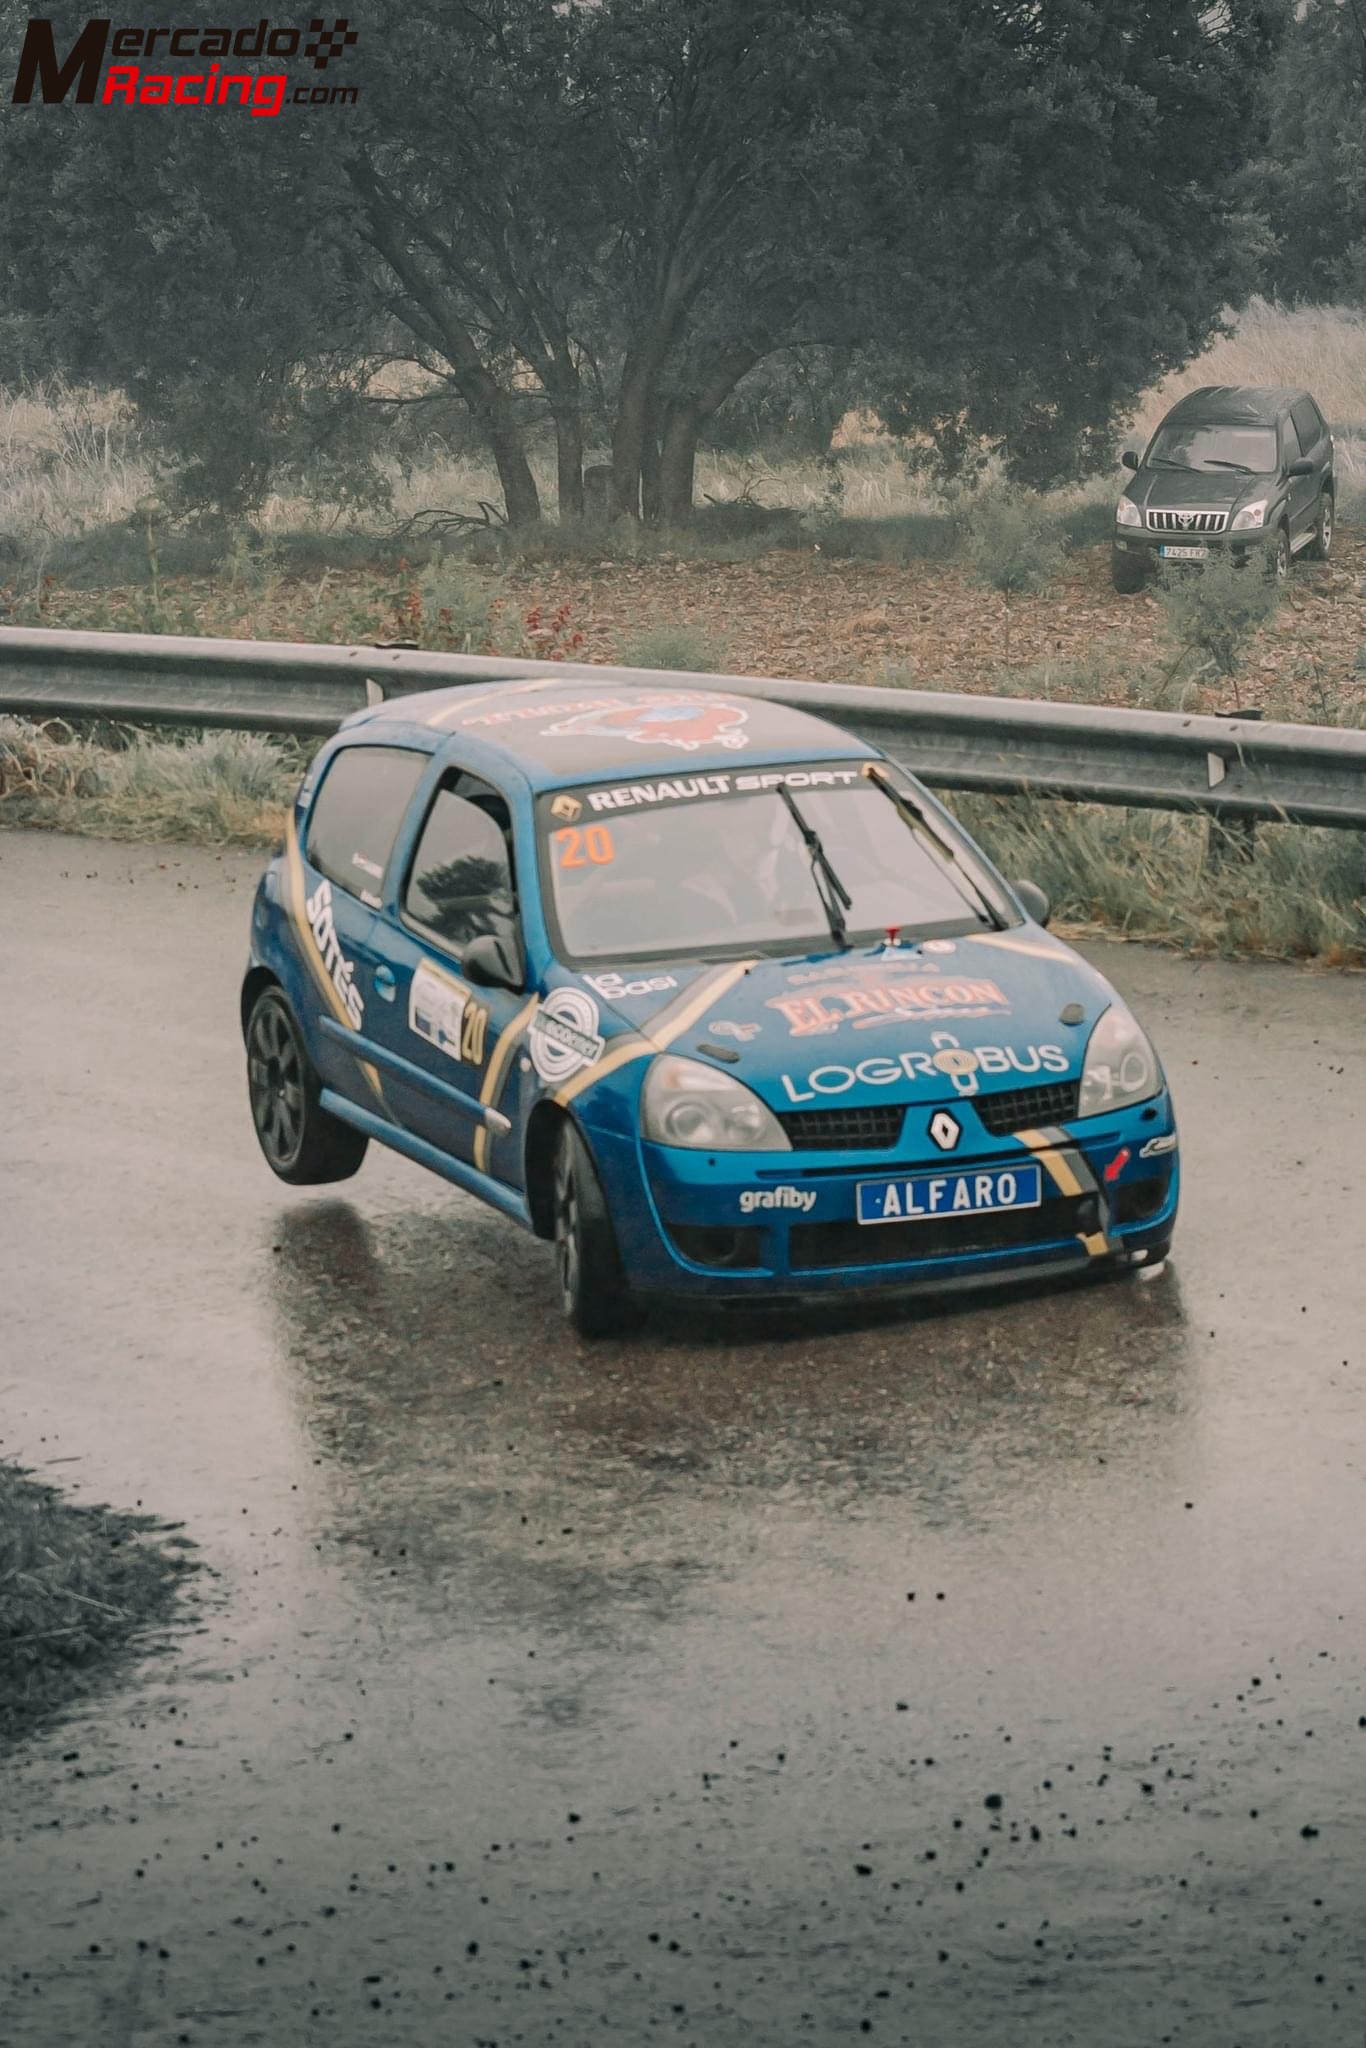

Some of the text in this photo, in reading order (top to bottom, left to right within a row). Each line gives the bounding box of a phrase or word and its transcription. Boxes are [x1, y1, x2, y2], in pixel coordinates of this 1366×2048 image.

[587, 771, 858, 811] RENAULT SPORT
[556, 825, 615, 868] 20
[462, 1001, 488, 1065] 20
[739, 1185, 817, 1213] grafiby
[882, 1172, 1017, 1217] ALFARO
